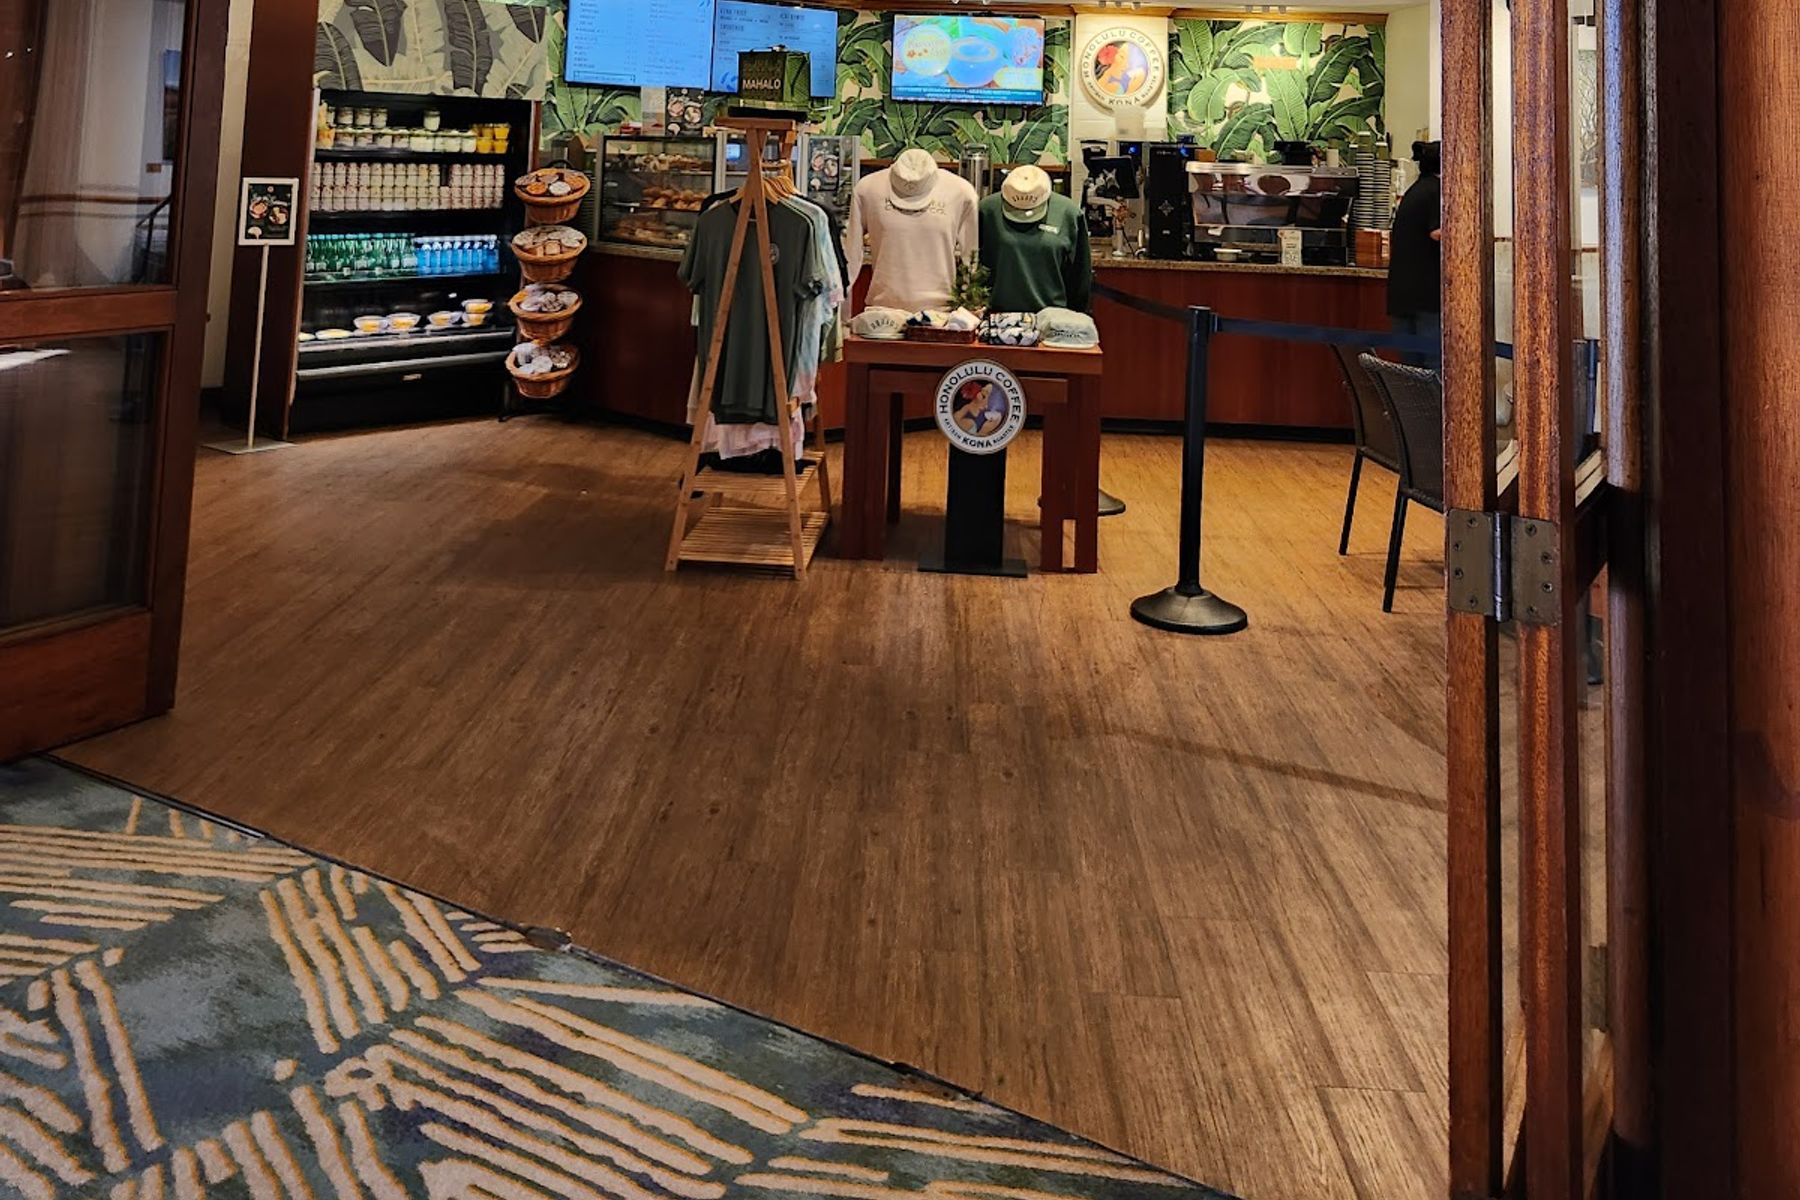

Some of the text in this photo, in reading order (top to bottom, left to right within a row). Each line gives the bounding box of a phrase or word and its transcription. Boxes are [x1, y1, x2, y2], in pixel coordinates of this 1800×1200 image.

[1083, 30, 1160, 78] HONOLULU COFFEE
[742, 79, 782, 90] MAHALO
[939, 366, 1021, 424] HONOLULU COFFEE
[961, 437, 993, 448] KONA
